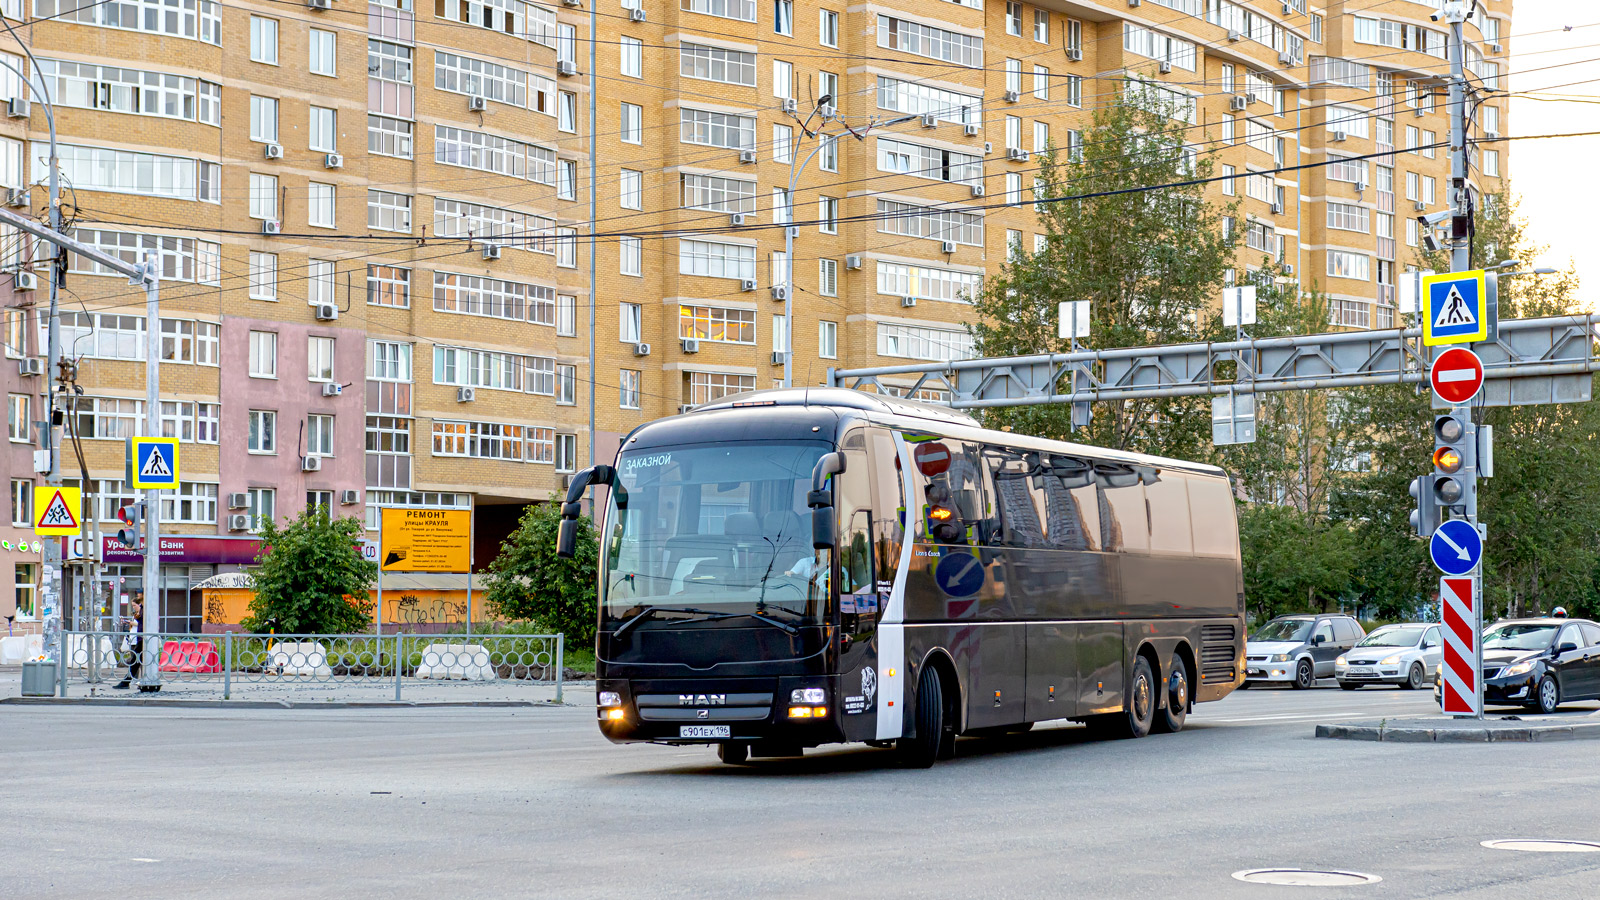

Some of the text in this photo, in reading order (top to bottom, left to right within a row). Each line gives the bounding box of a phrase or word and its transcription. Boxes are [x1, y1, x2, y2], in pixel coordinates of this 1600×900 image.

[625, 453, 672, 470] ЗАКАЗНОЙ
[161, 540, 184, 549] Банк
[679, 694, 726, 705] MAN
[715, 726, 728, 734] 196
